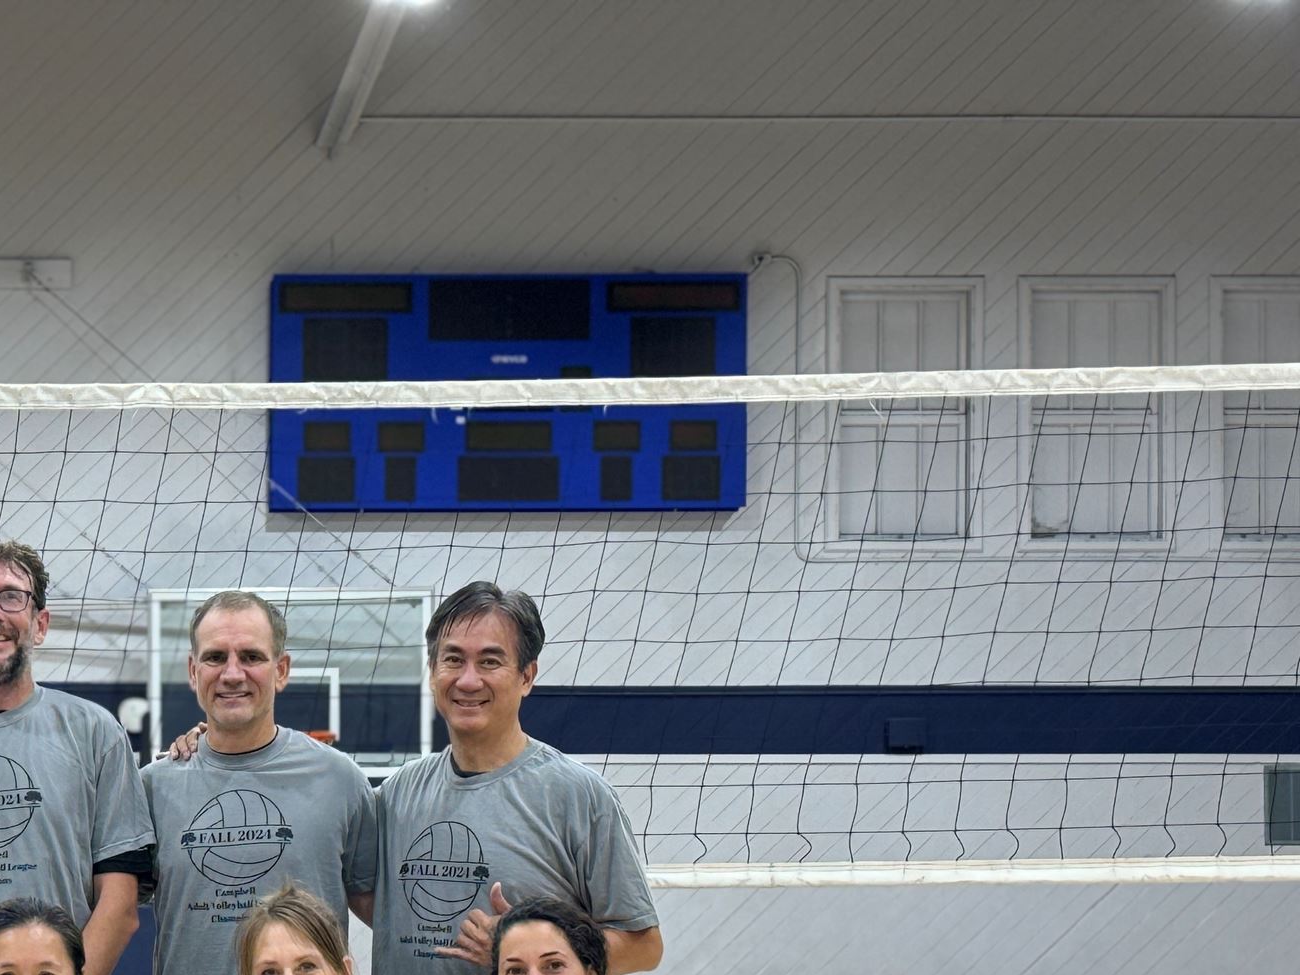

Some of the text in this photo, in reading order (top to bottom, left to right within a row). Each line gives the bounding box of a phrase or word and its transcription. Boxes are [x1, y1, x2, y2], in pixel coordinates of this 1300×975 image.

[199, 829, 272, 844] FALL 2024
[8, 863, 38, 873] League
[410, 864, 470, 878] FALL 2024
[215, 887, 256, 898] Campbell
